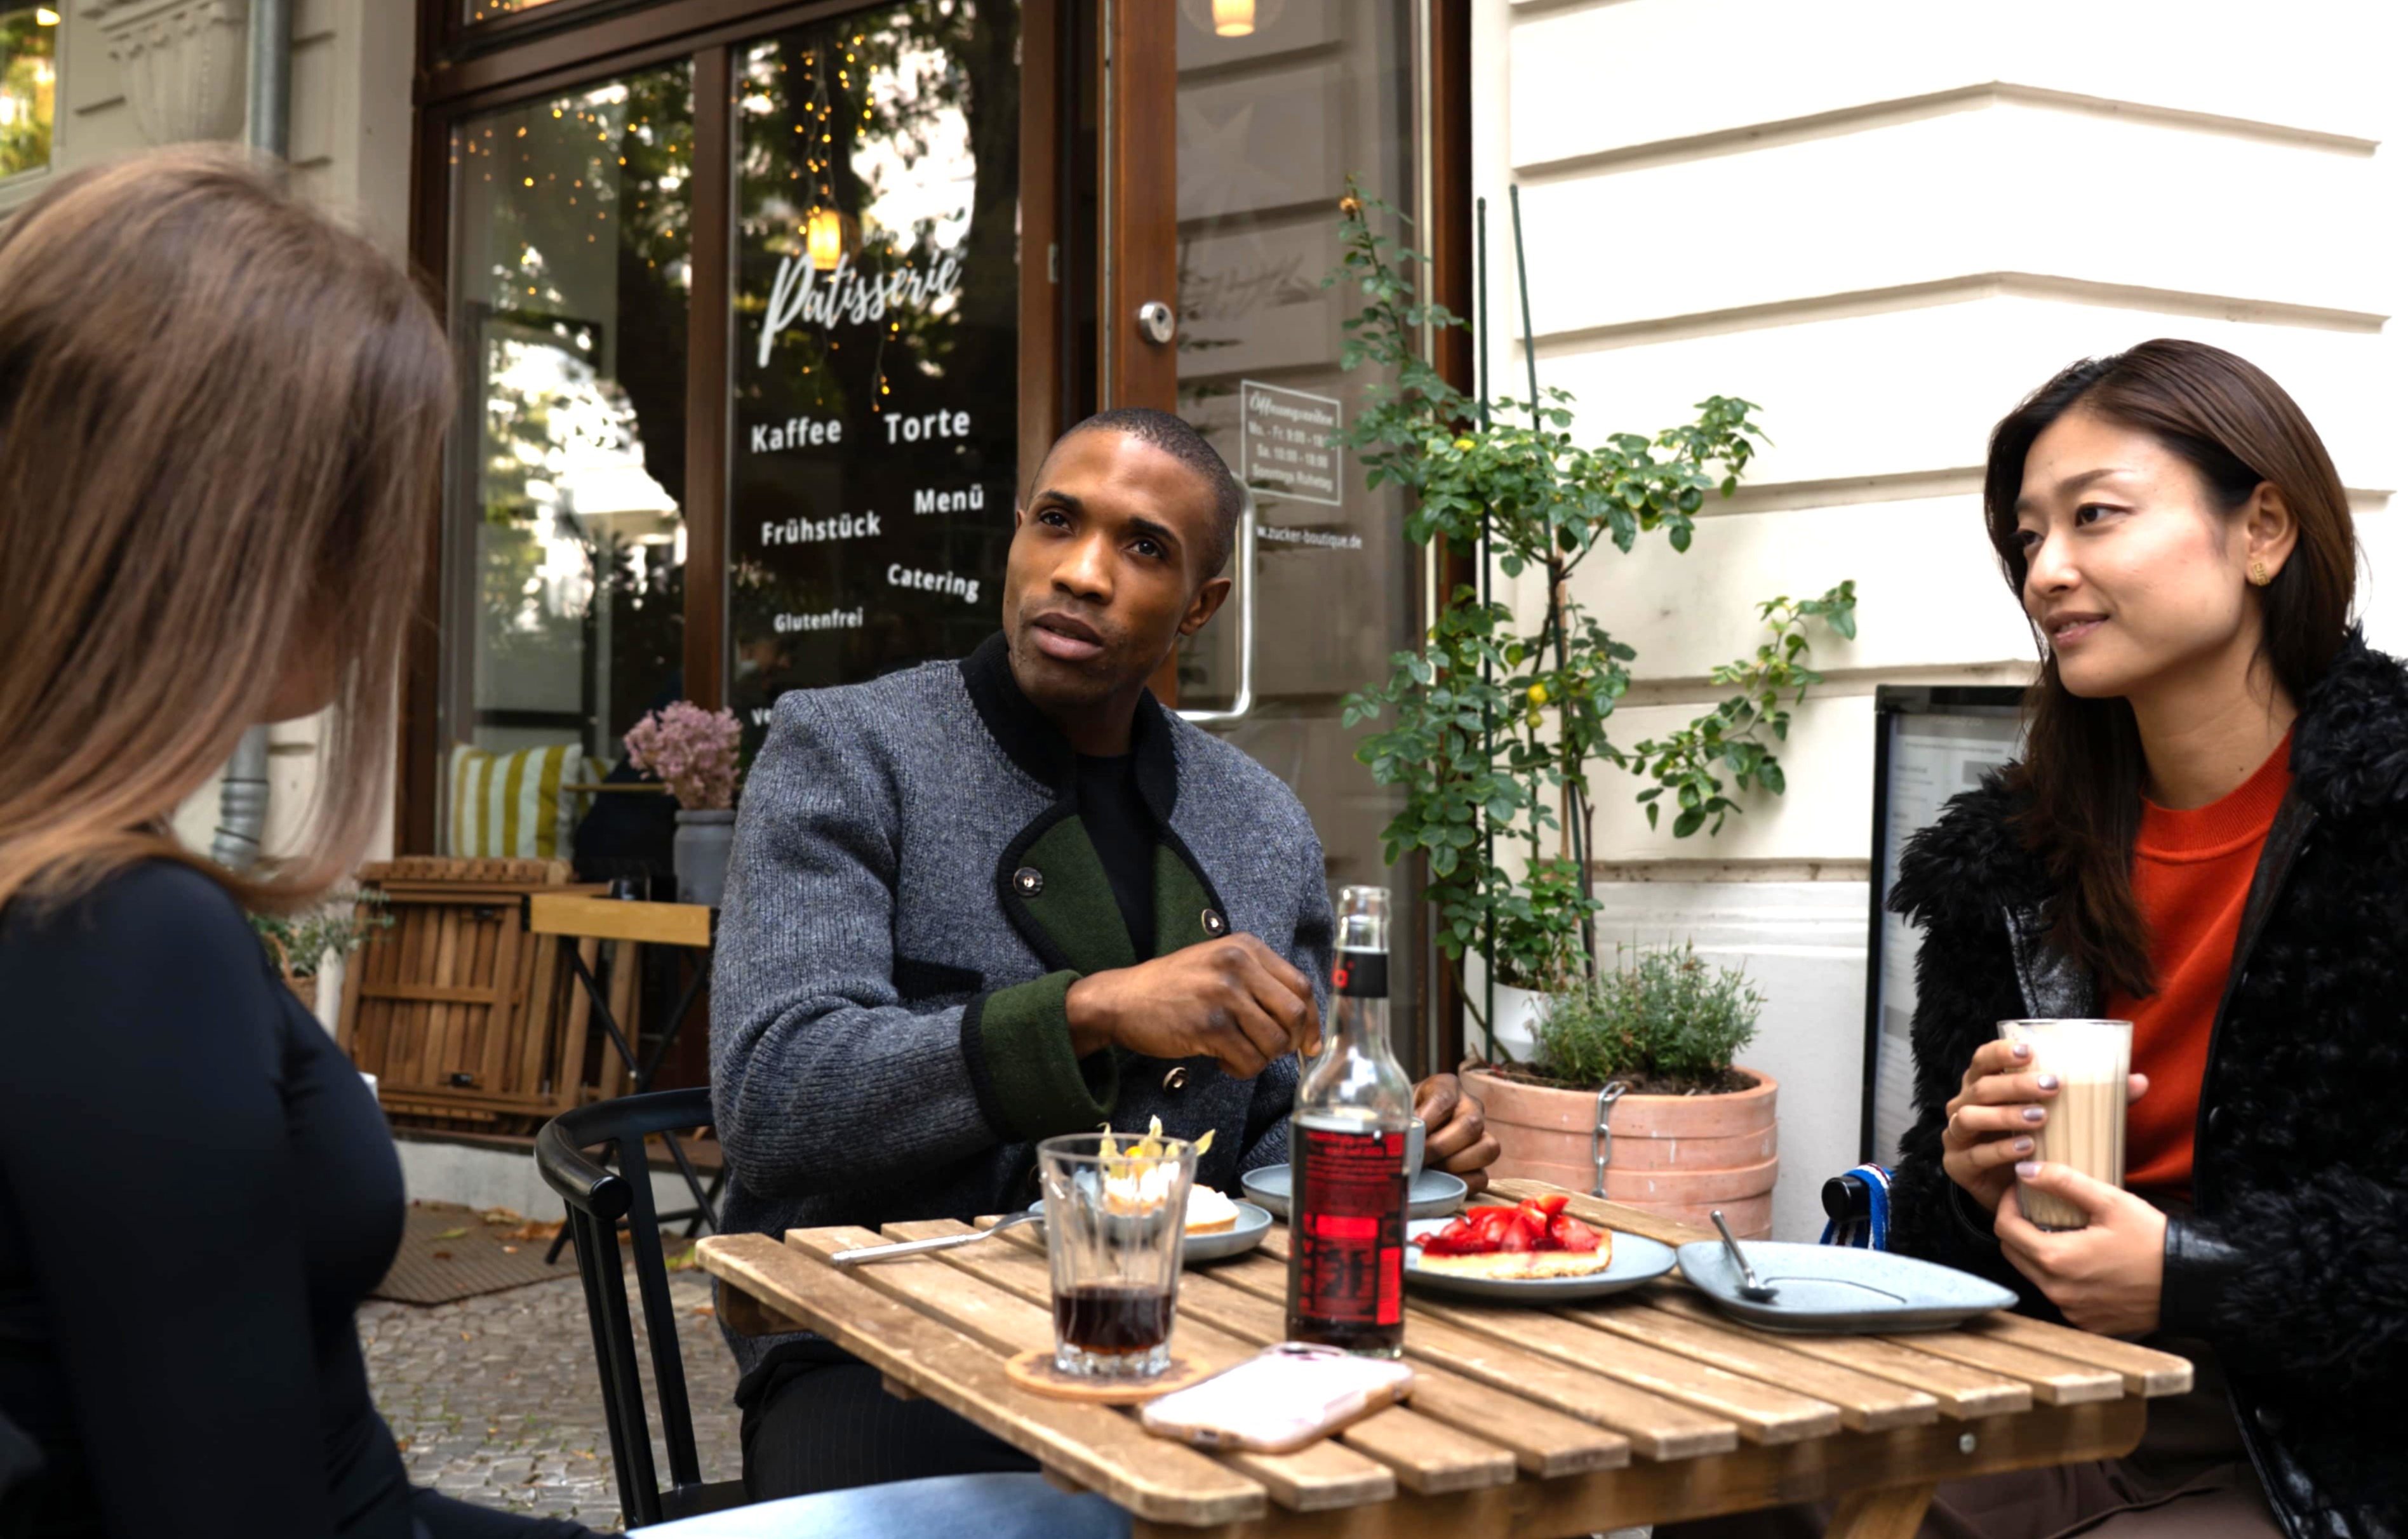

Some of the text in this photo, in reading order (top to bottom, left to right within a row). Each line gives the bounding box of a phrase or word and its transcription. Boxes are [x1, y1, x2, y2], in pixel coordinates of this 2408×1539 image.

[758, 251, 963, 368] Patisserie
[751, 417, 843, 453] Kaffee
[884, 409, 972, 444] Torte
[914, 484, 985, 514] Menü
[761, 510, 881, 547] Frühstück
[887, 563, 980, 604] Catering
[773, 606, 864, 633] Glutenfrei
